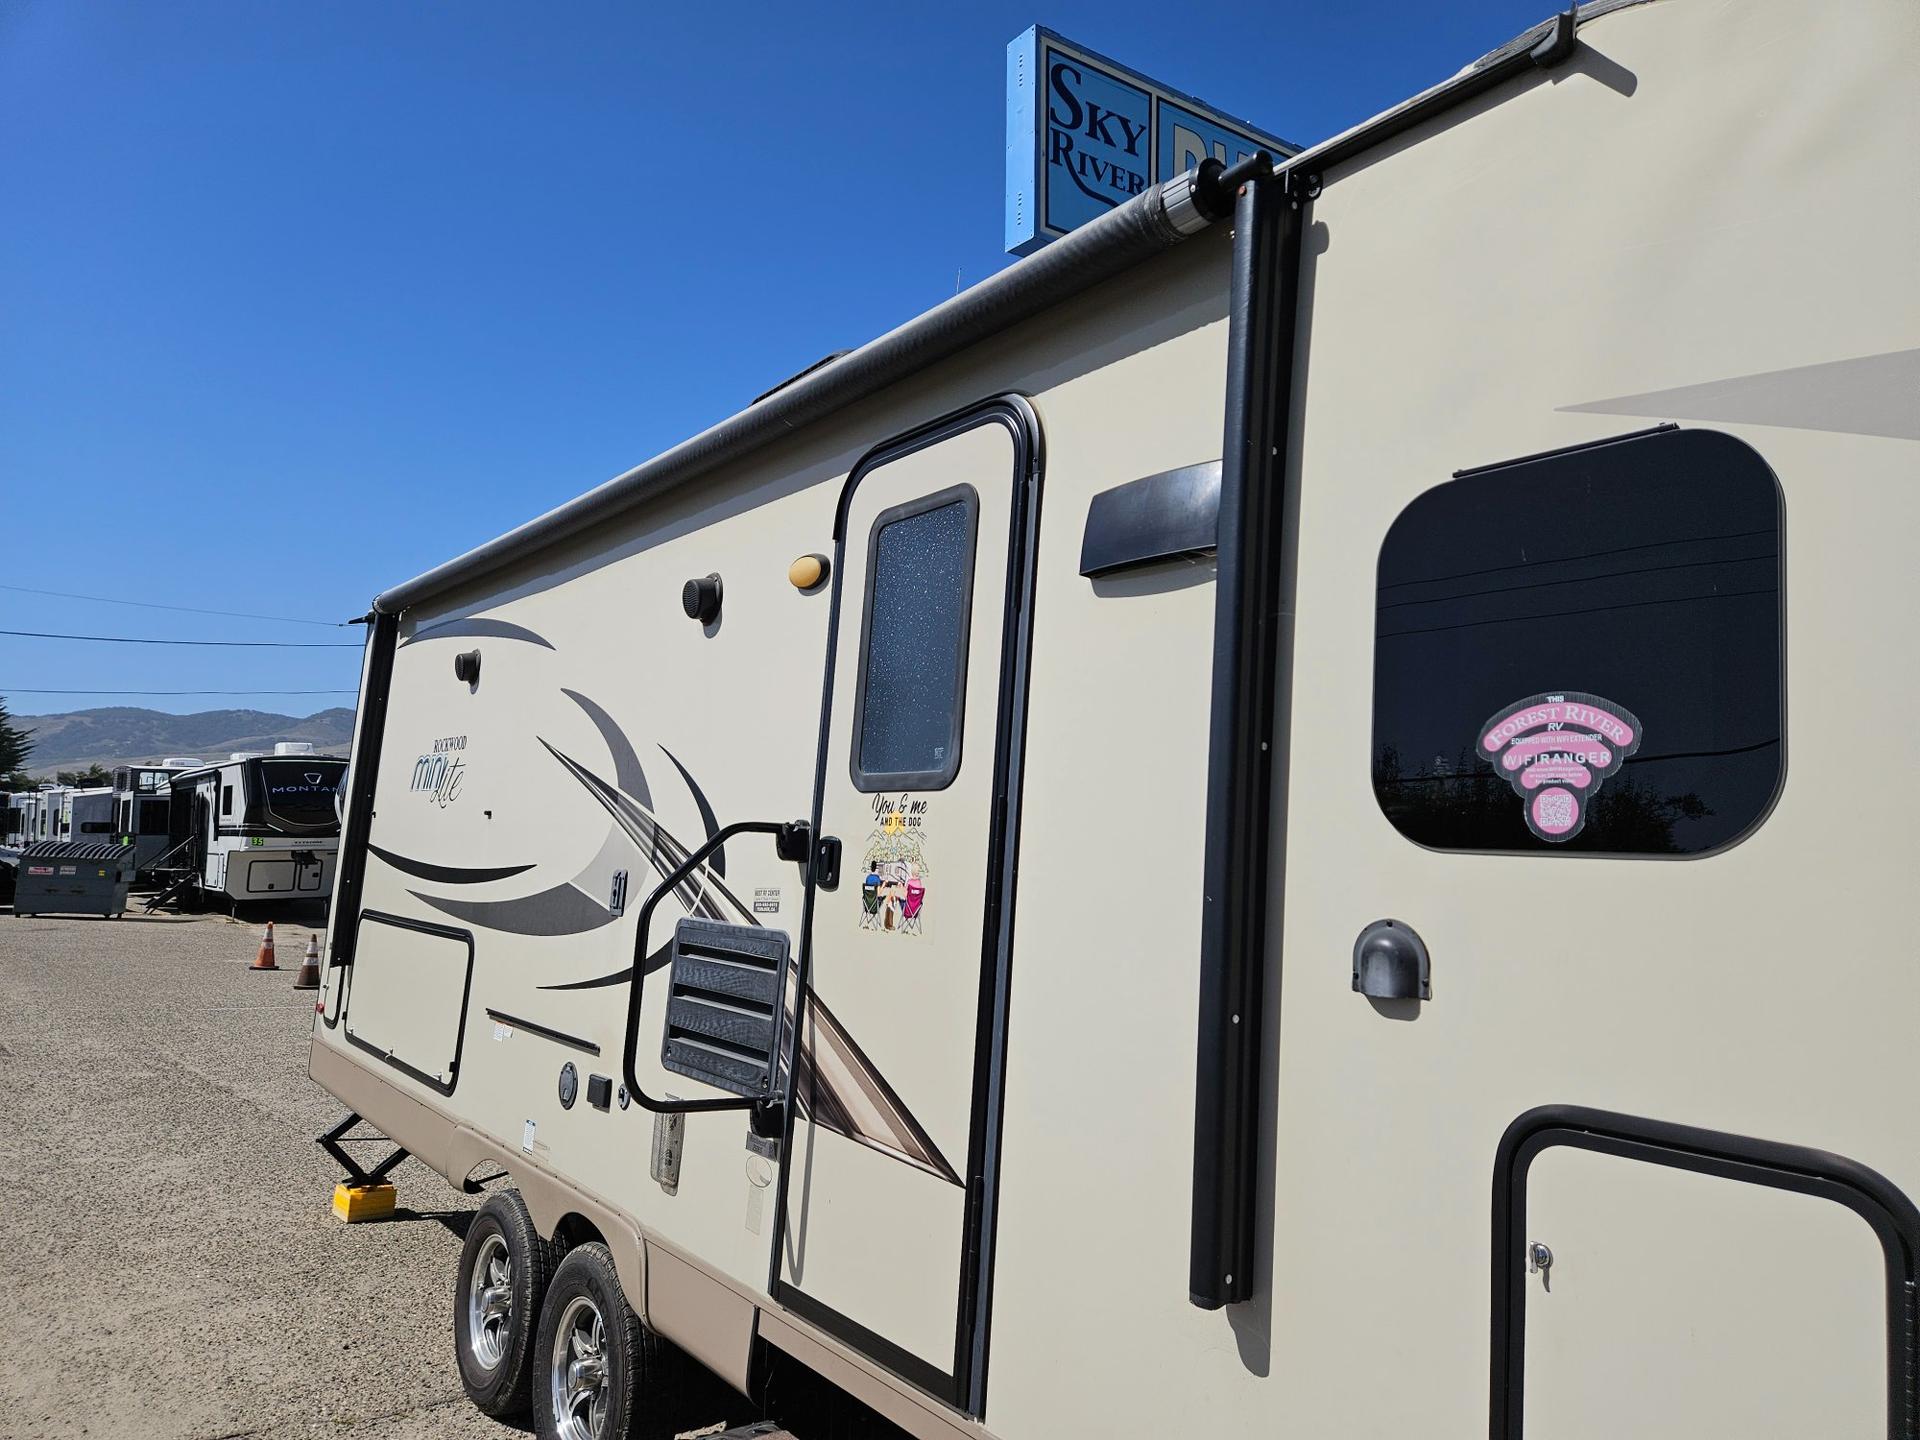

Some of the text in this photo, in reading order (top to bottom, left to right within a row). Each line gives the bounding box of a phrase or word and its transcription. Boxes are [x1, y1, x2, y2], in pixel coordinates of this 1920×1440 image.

[1050, 63, 1146, 158] SKY
[1050, 127, 1145, 206] RIVER
[1546, 695, 1565, 704] THIS
[1489, 704, 1624, 746] FOREST RIVER
[1547, 722, 1565, 732] RV
[1570, 733, 1603, 743] EXTENDER
[872, 792, 928, 821] You & me
[880, 817, 922, 826] AND THE DOG
